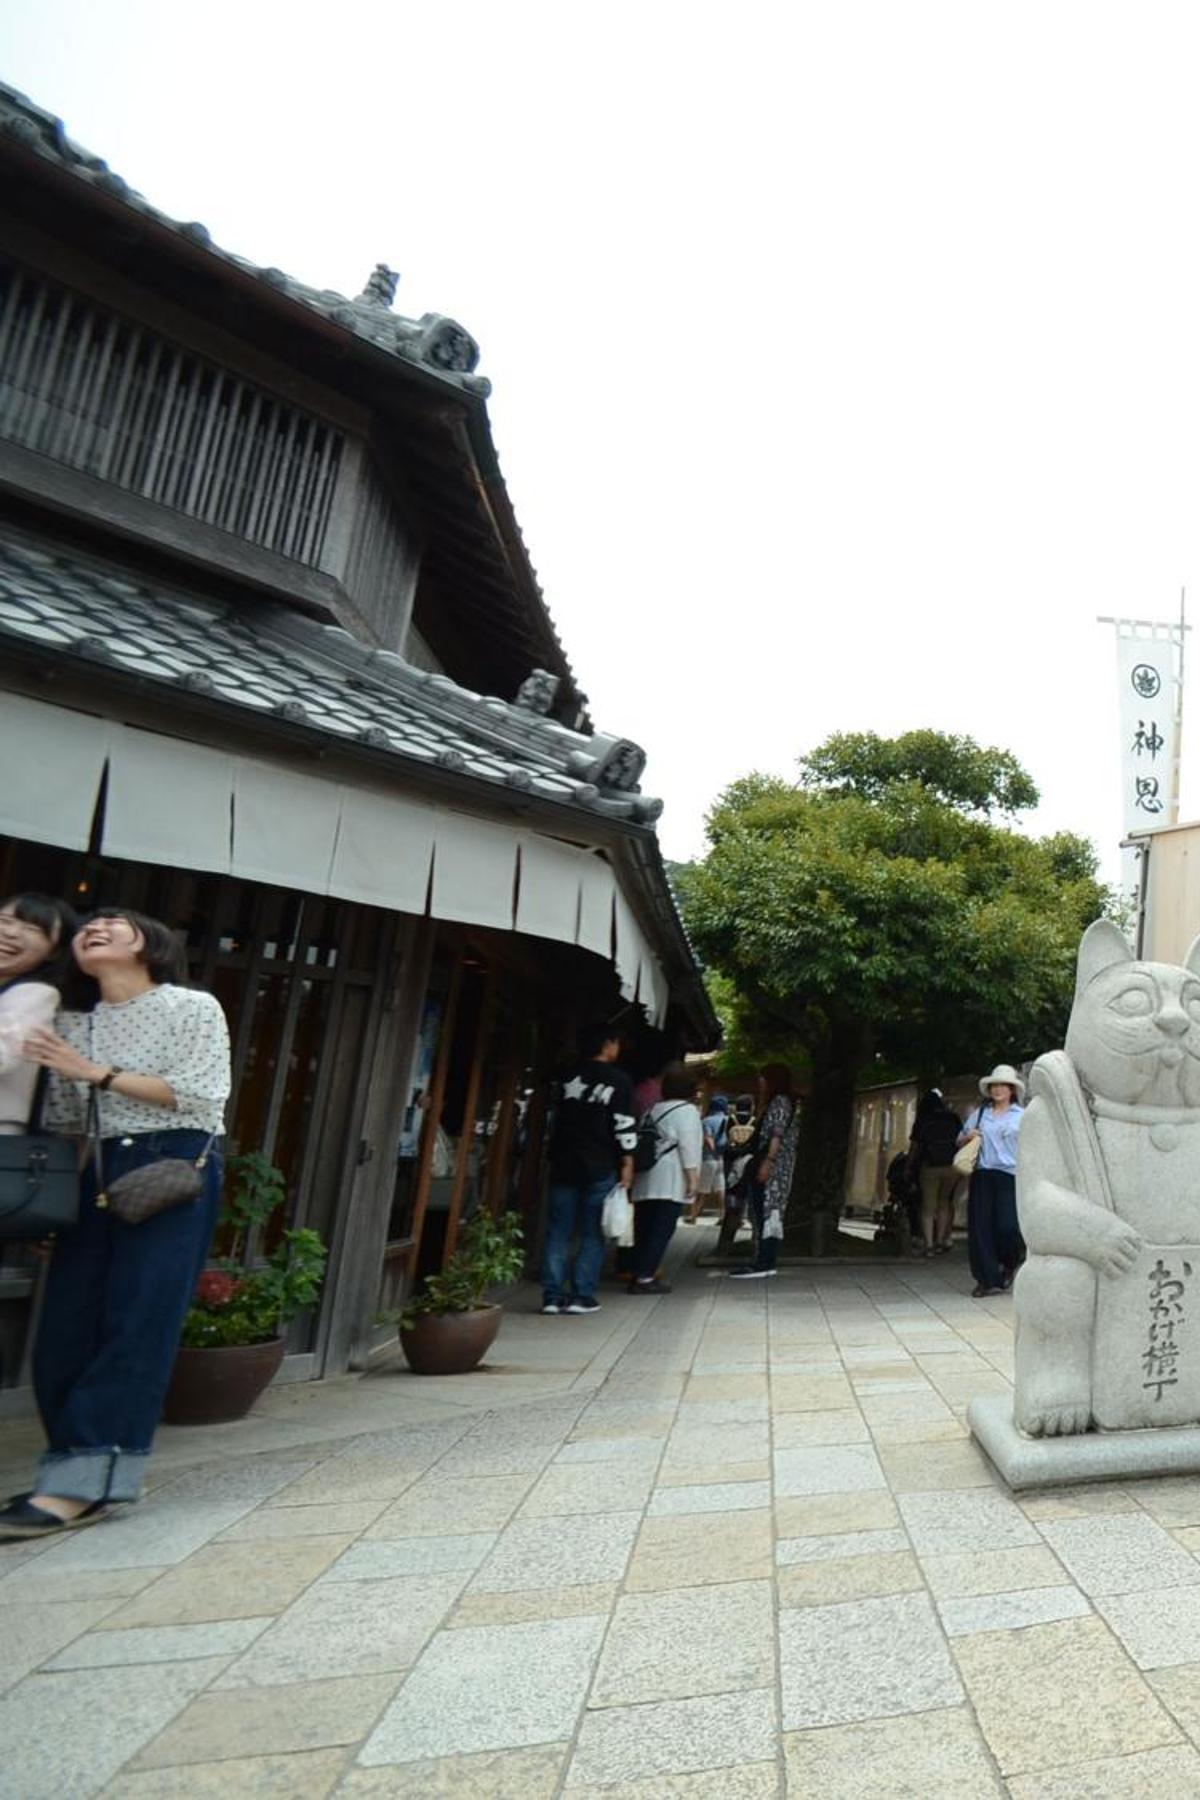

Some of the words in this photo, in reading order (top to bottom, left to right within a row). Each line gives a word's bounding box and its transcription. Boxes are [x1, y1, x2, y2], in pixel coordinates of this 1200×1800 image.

[1131, 721, 1165, 813] 神恩
[1141, 1259, 1193, 1403] おかげ横丁
